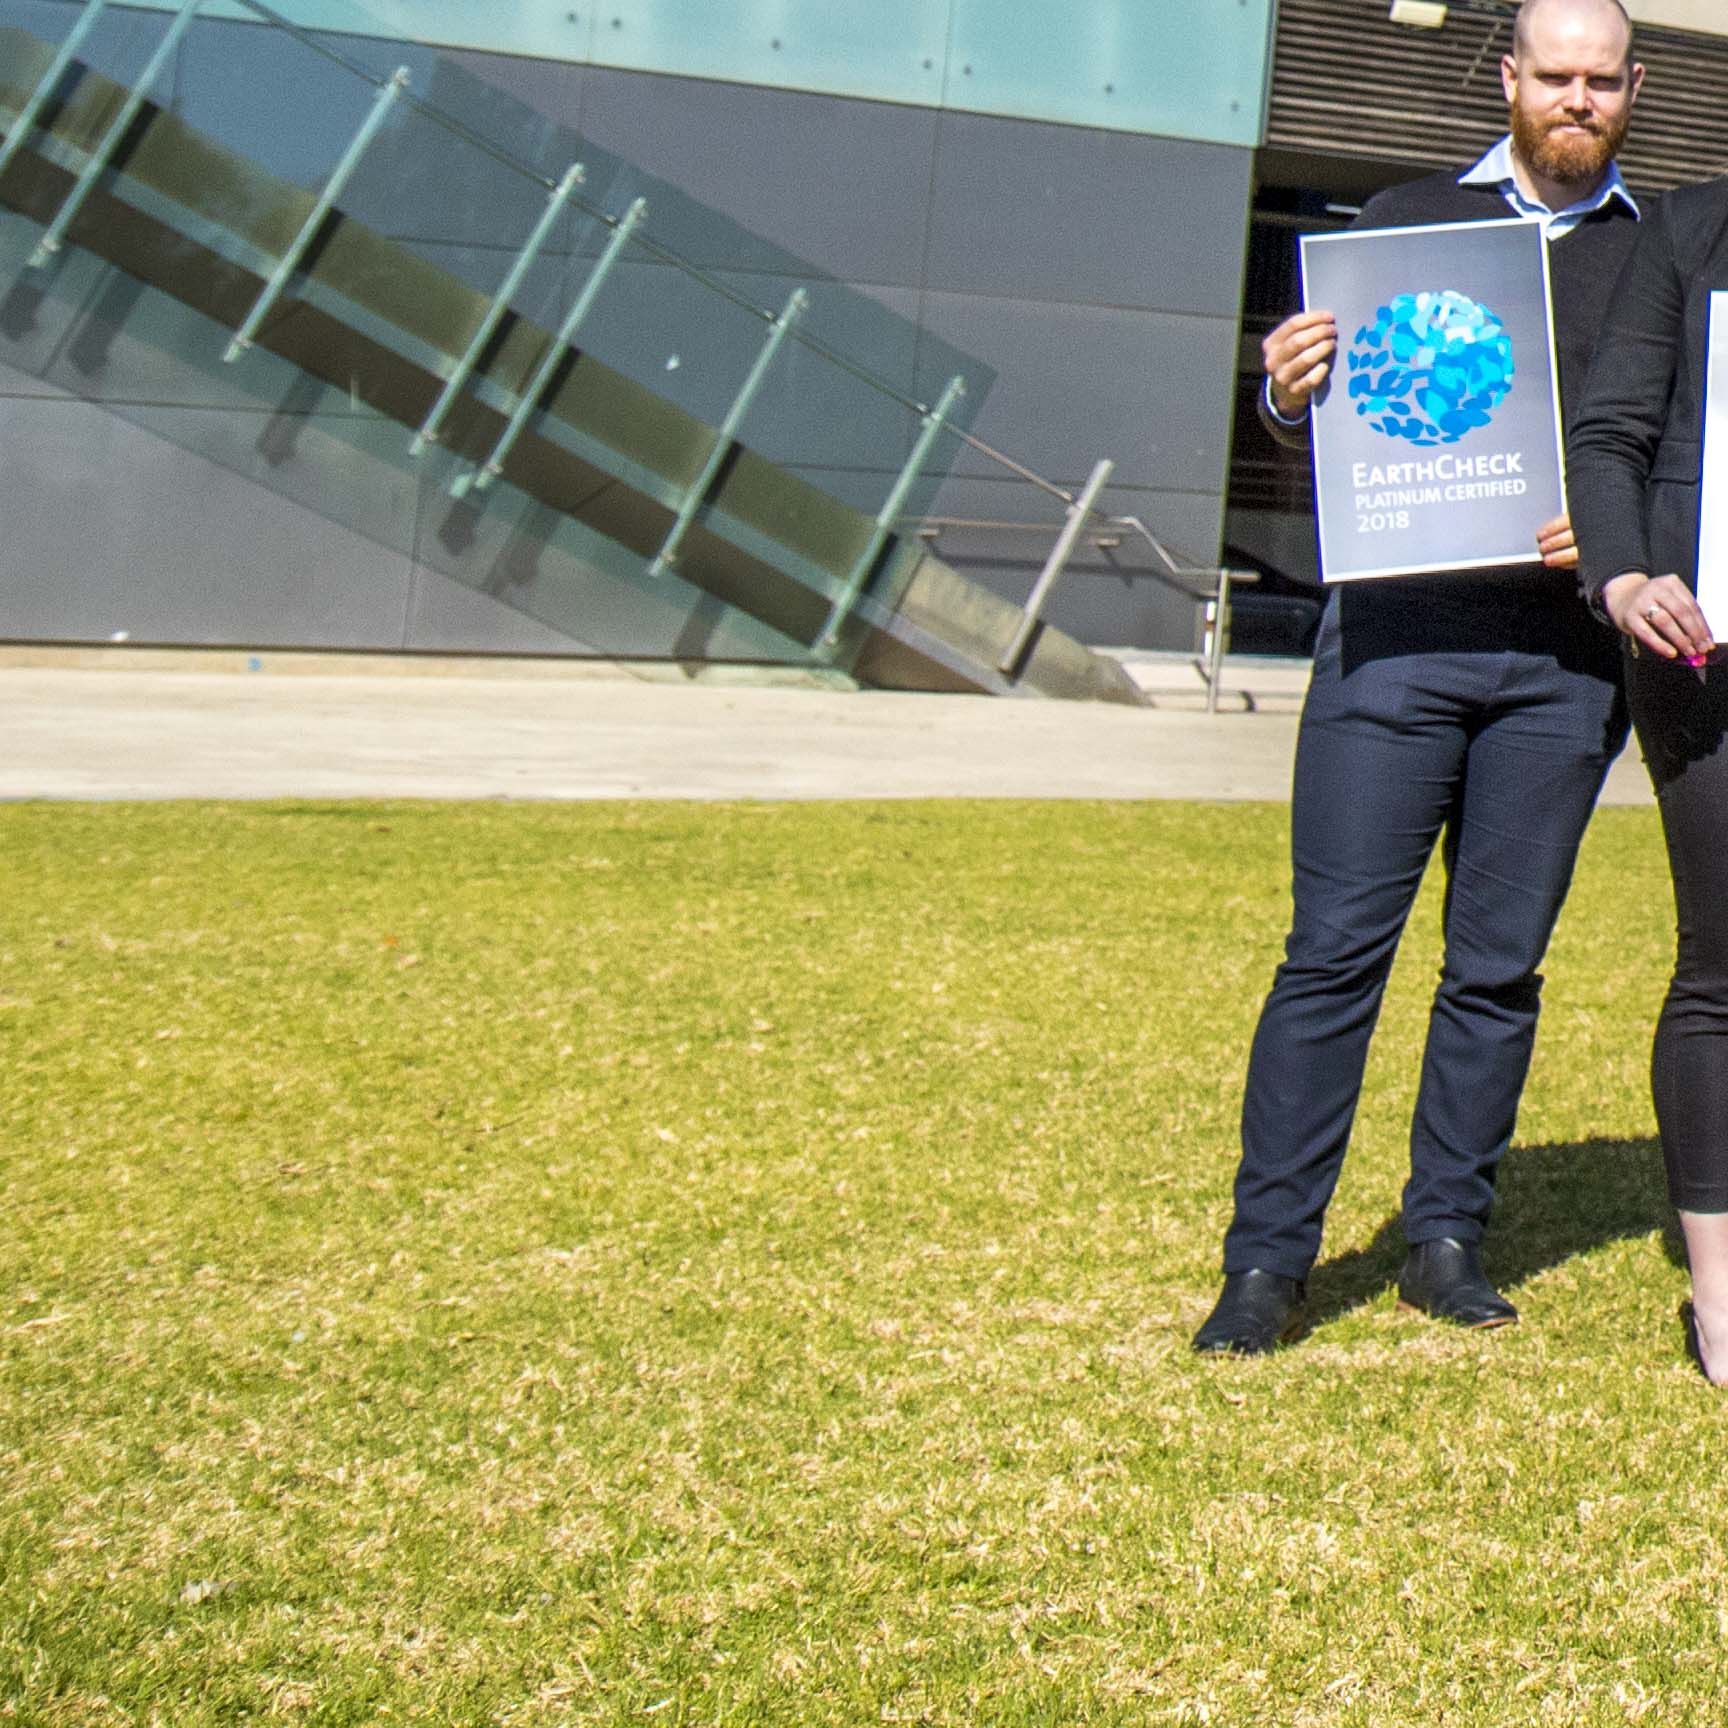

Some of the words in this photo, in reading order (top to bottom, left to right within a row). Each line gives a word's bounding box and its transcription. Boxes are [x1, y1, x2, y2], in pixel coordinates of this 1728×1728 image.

[1352, 452, 1523, 488] EARTHCHECK
[1355, 487, 1442, 510] PLATINUM
[1444, 478, 1527, 501] CERTIFIED
[1357, 510, 1410, 533] 2018
